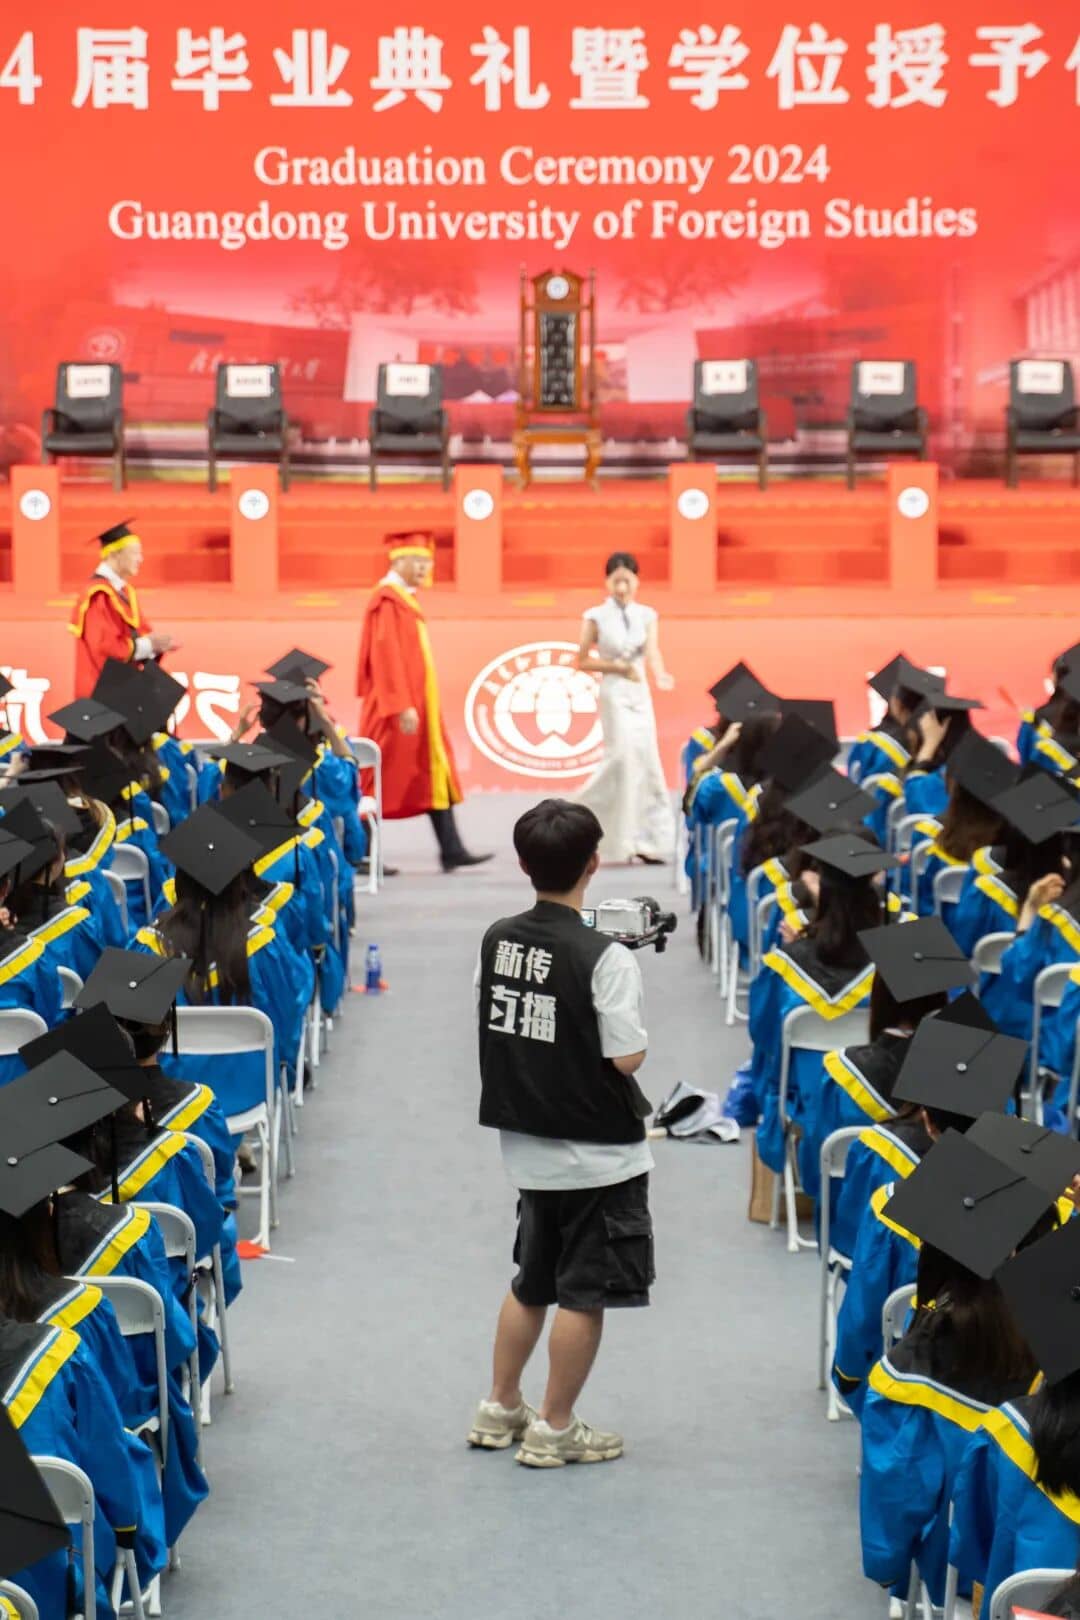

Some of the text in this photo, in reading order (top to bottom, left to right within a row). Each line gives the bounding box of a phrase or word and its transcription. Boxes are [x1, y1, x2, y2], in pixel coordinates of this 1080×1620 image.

[0, 23, 1080, 113] 4届毕业典礼暨学位授予
[253, 144, 831, 195] Graduation Ceremony 2024
[107, 197, 978, 251] Guangdong University of Foreign Studies
[493, 939, 553, 985] 新传
